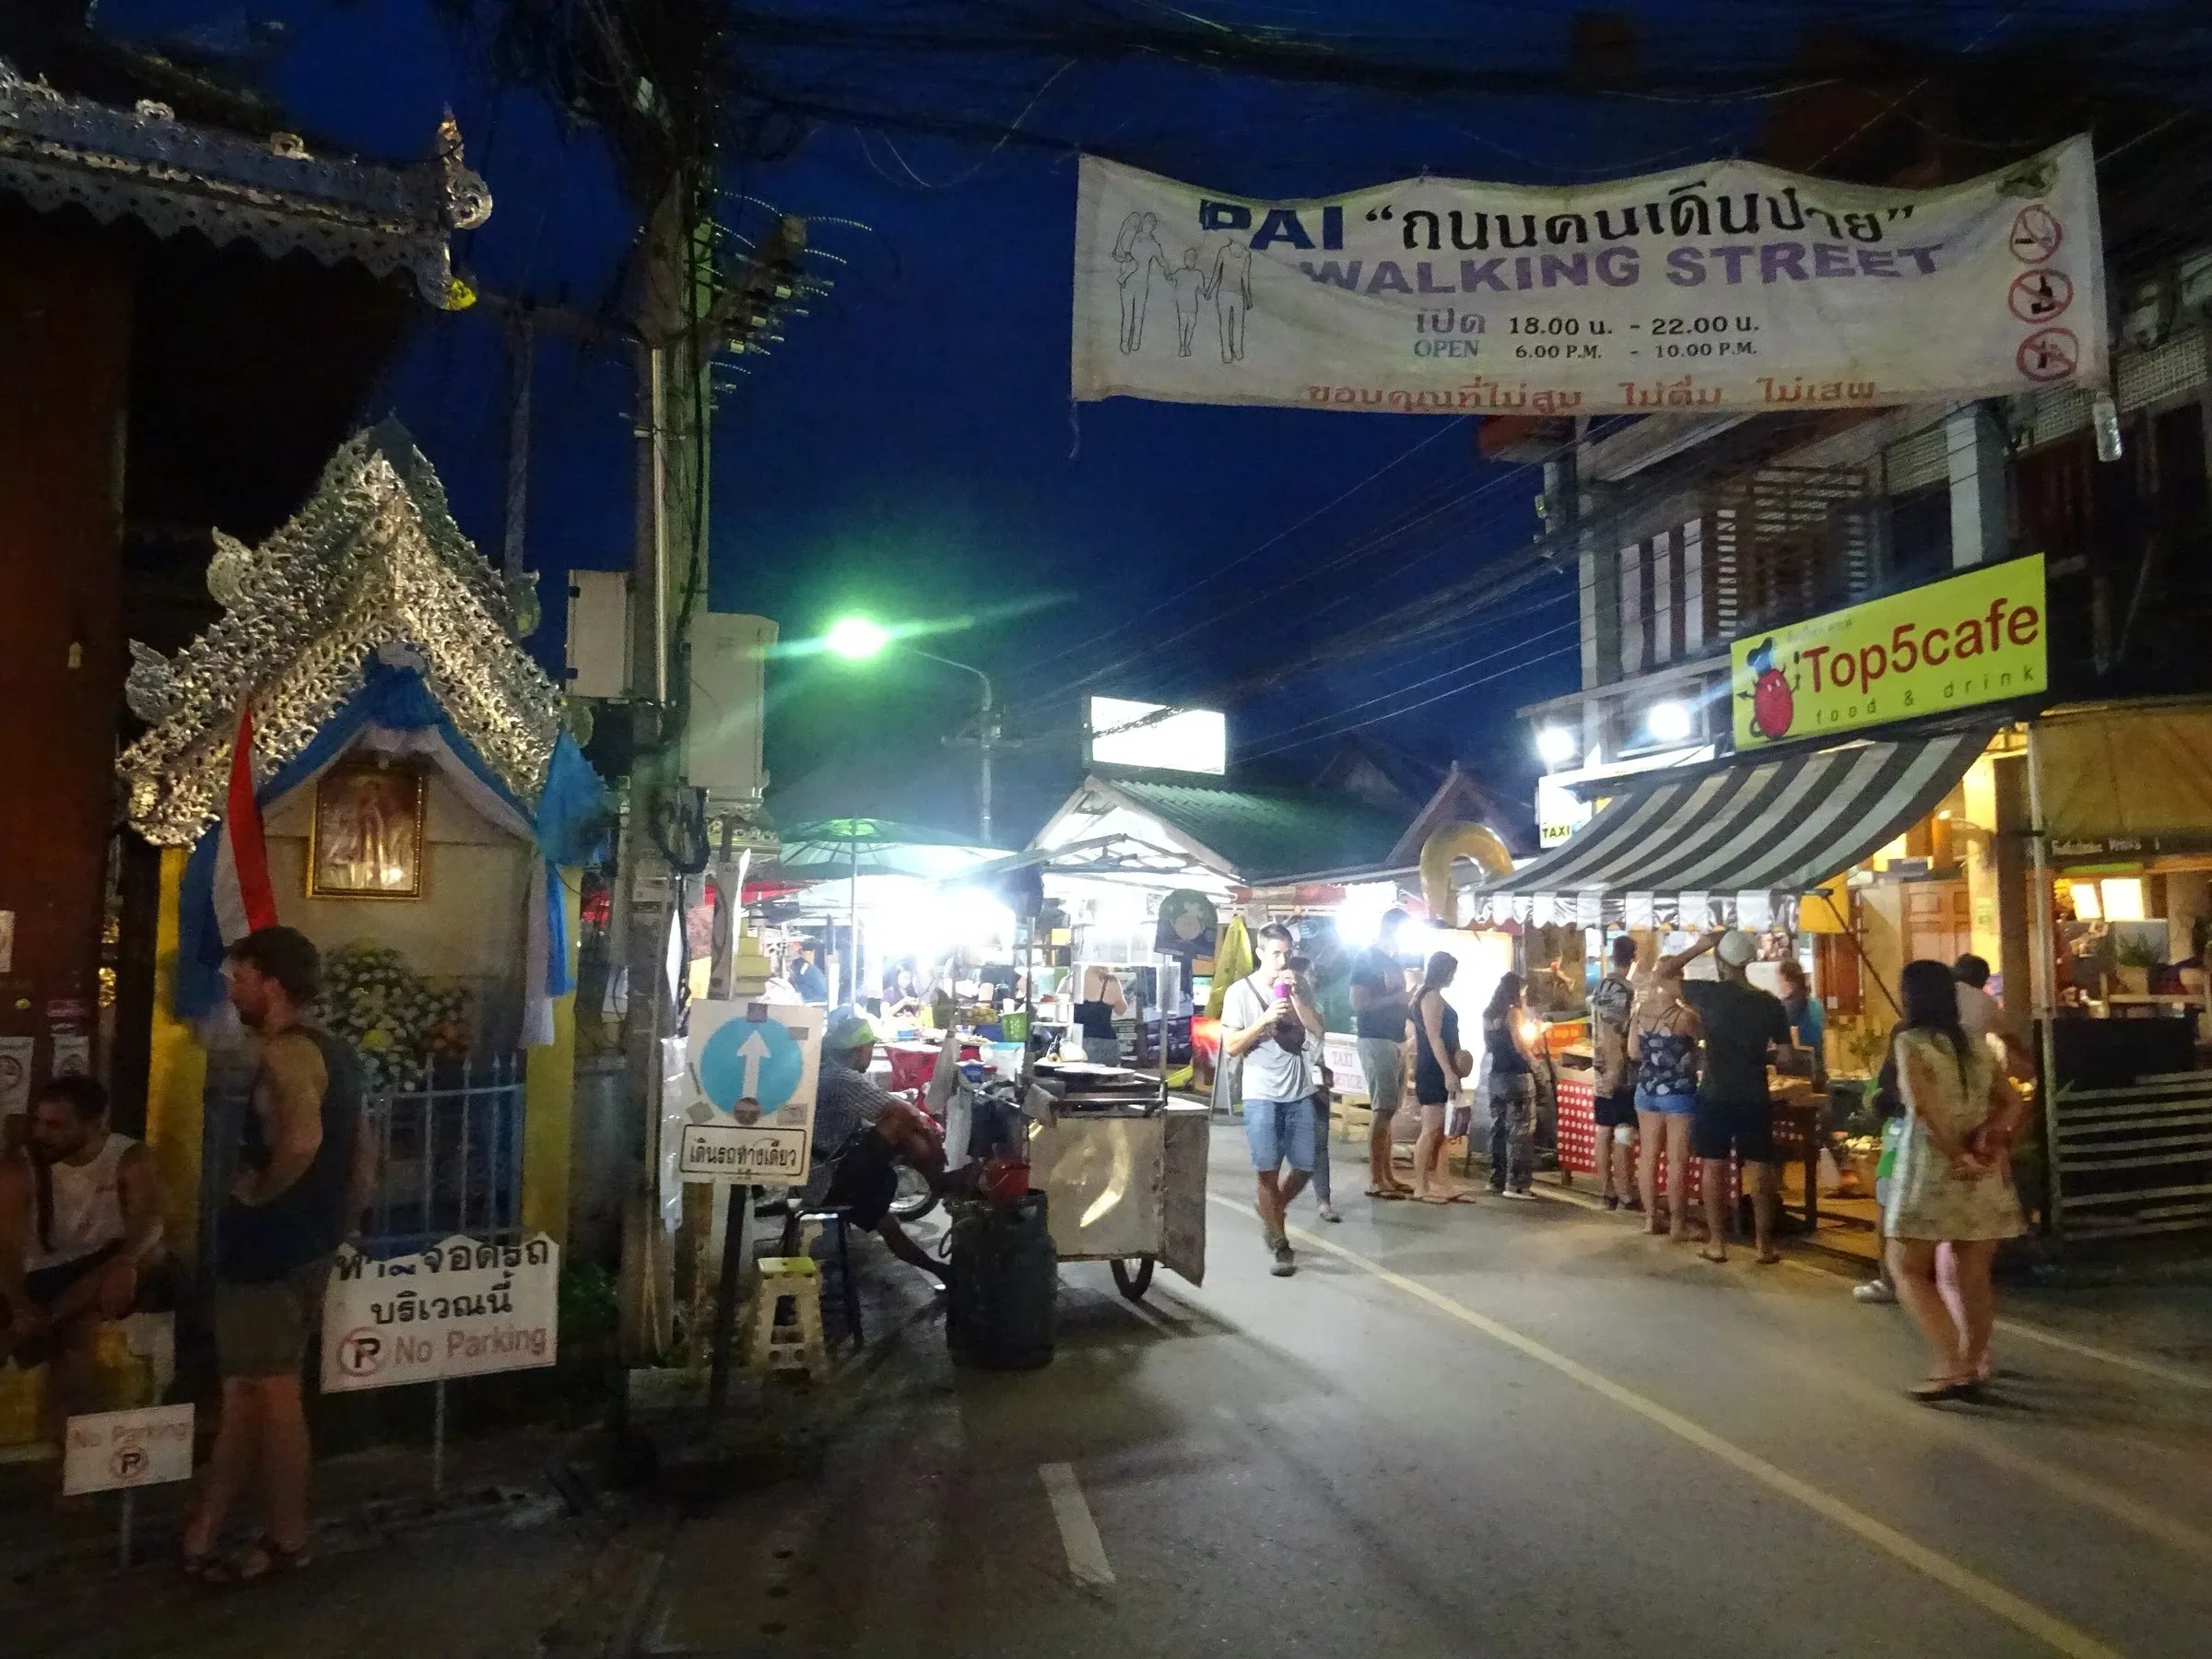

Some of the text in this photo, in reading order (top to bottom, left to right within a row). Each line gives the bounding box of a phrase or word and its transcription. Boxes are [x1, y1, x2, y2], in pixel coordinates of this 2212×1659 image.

[1199, 198, 1345, 251] PAI
[1299, 241, 1947, 295] WALKING STREET
[1414, 340, 1480, 358] OPEN
[1515, 342, 1561, 359] 6.00
[1566, 342, 1602, 359] P.M.
[1655, 341, 1712, 359] 10.00
[1719, 341, 1757, 357] P.M.
[1509, 316, 1579, 336] 18.00
[1588, 319, 1612, 335] น.
[1651, 316, 1729, 335] 22.00
[1735, 317, 1759, 334] น.
[1801, 597, 2040, 694] Top5cafe
[1816, 665, 2034, 724] food & drink
[1542, 825, 1571, 839] TAXI
[371, 1270, 513, 1325] บริเวณนี้
[394, 1336, 434, 1365] No
[446, 1325, 547, 1359] Parking
